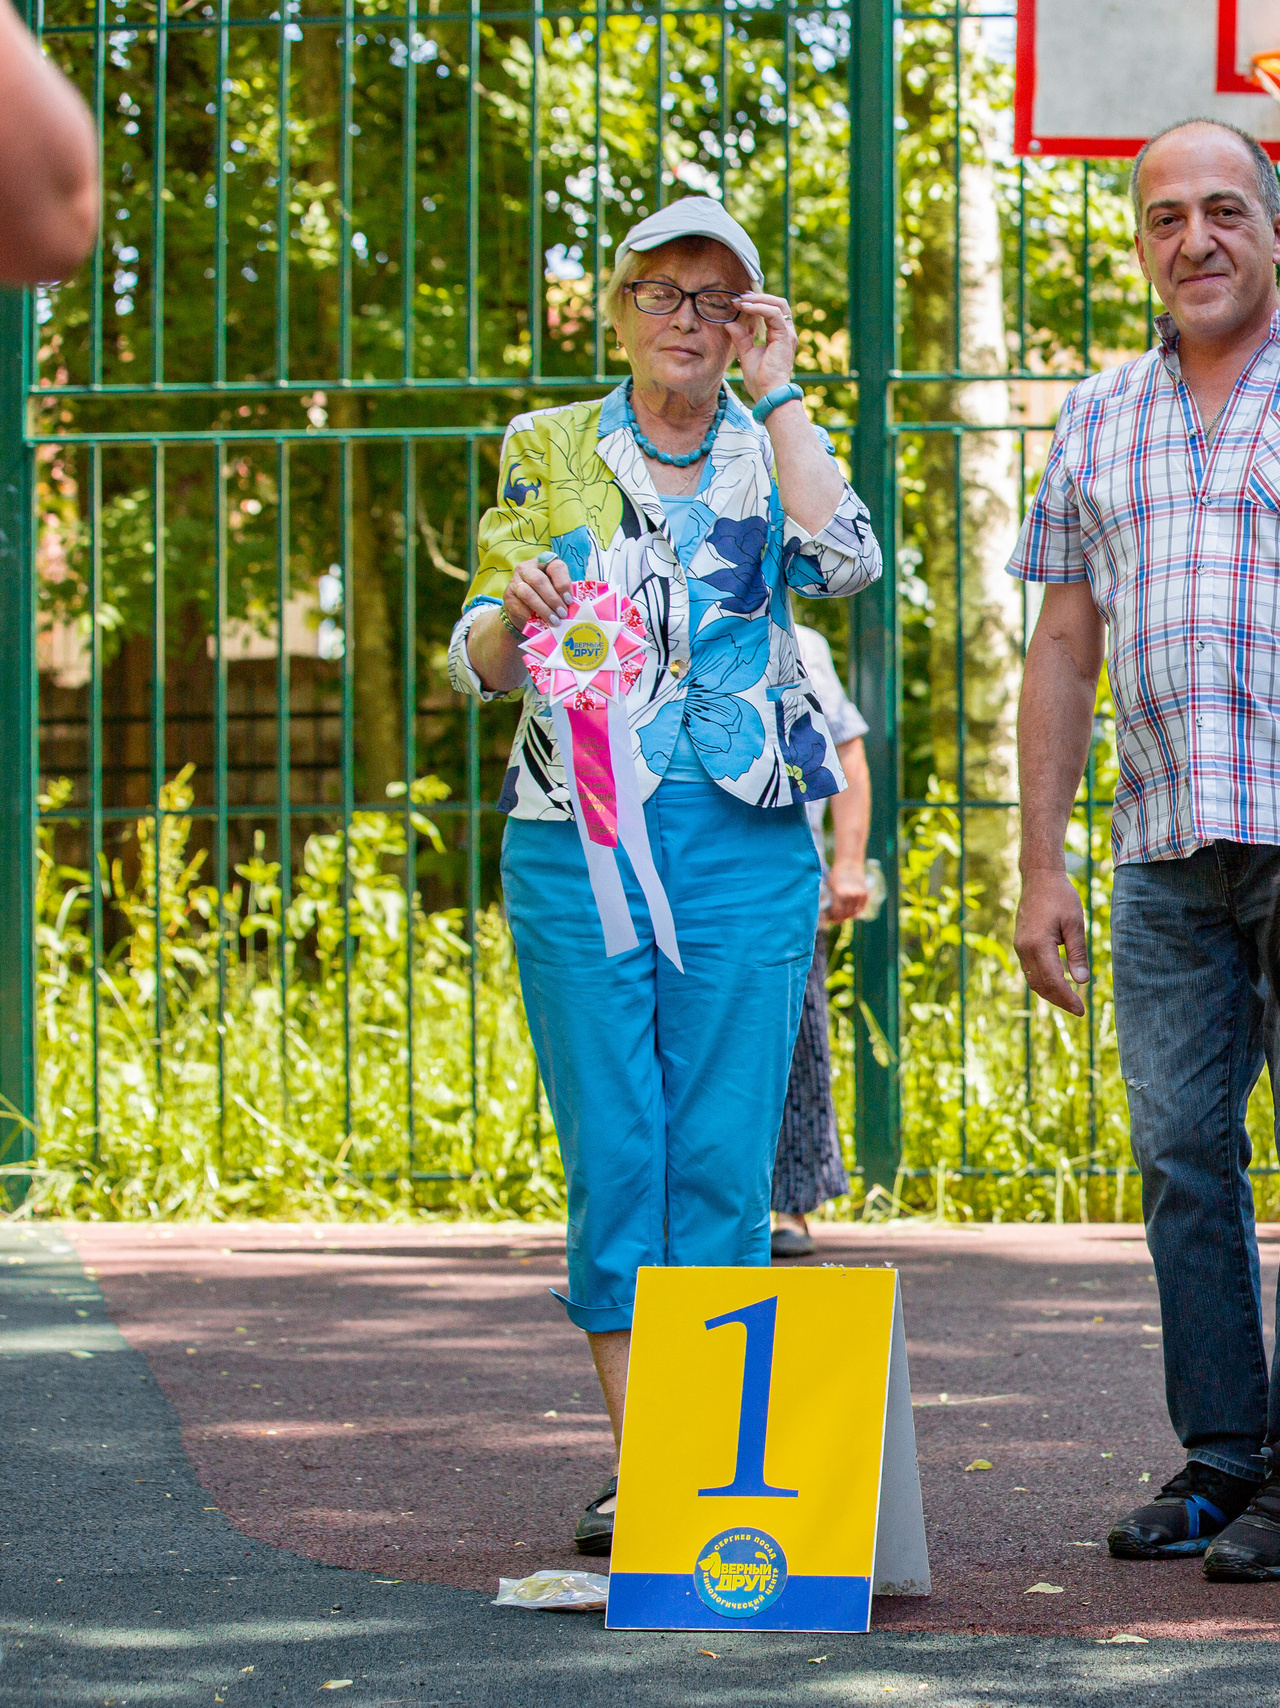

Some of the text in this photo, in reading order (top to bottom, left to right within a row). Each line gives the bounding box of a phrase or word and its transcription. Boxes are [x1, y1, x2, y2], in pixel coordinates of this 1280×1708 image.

[572, 648, 601, 657] ДРУГ
[698, 1295, 798, 1497] 1
[714, 1534, 777, 1560] СЕРГИЕВ ПОСАД
[721, 1563, 772, 1575] ВЕРНЫЙ
[703, 1567, 779, 1610] КИНОЛОГИЧЕСКИЙ ЦЕНТР
[714, 1574, 772, 1592] ДРУГ
